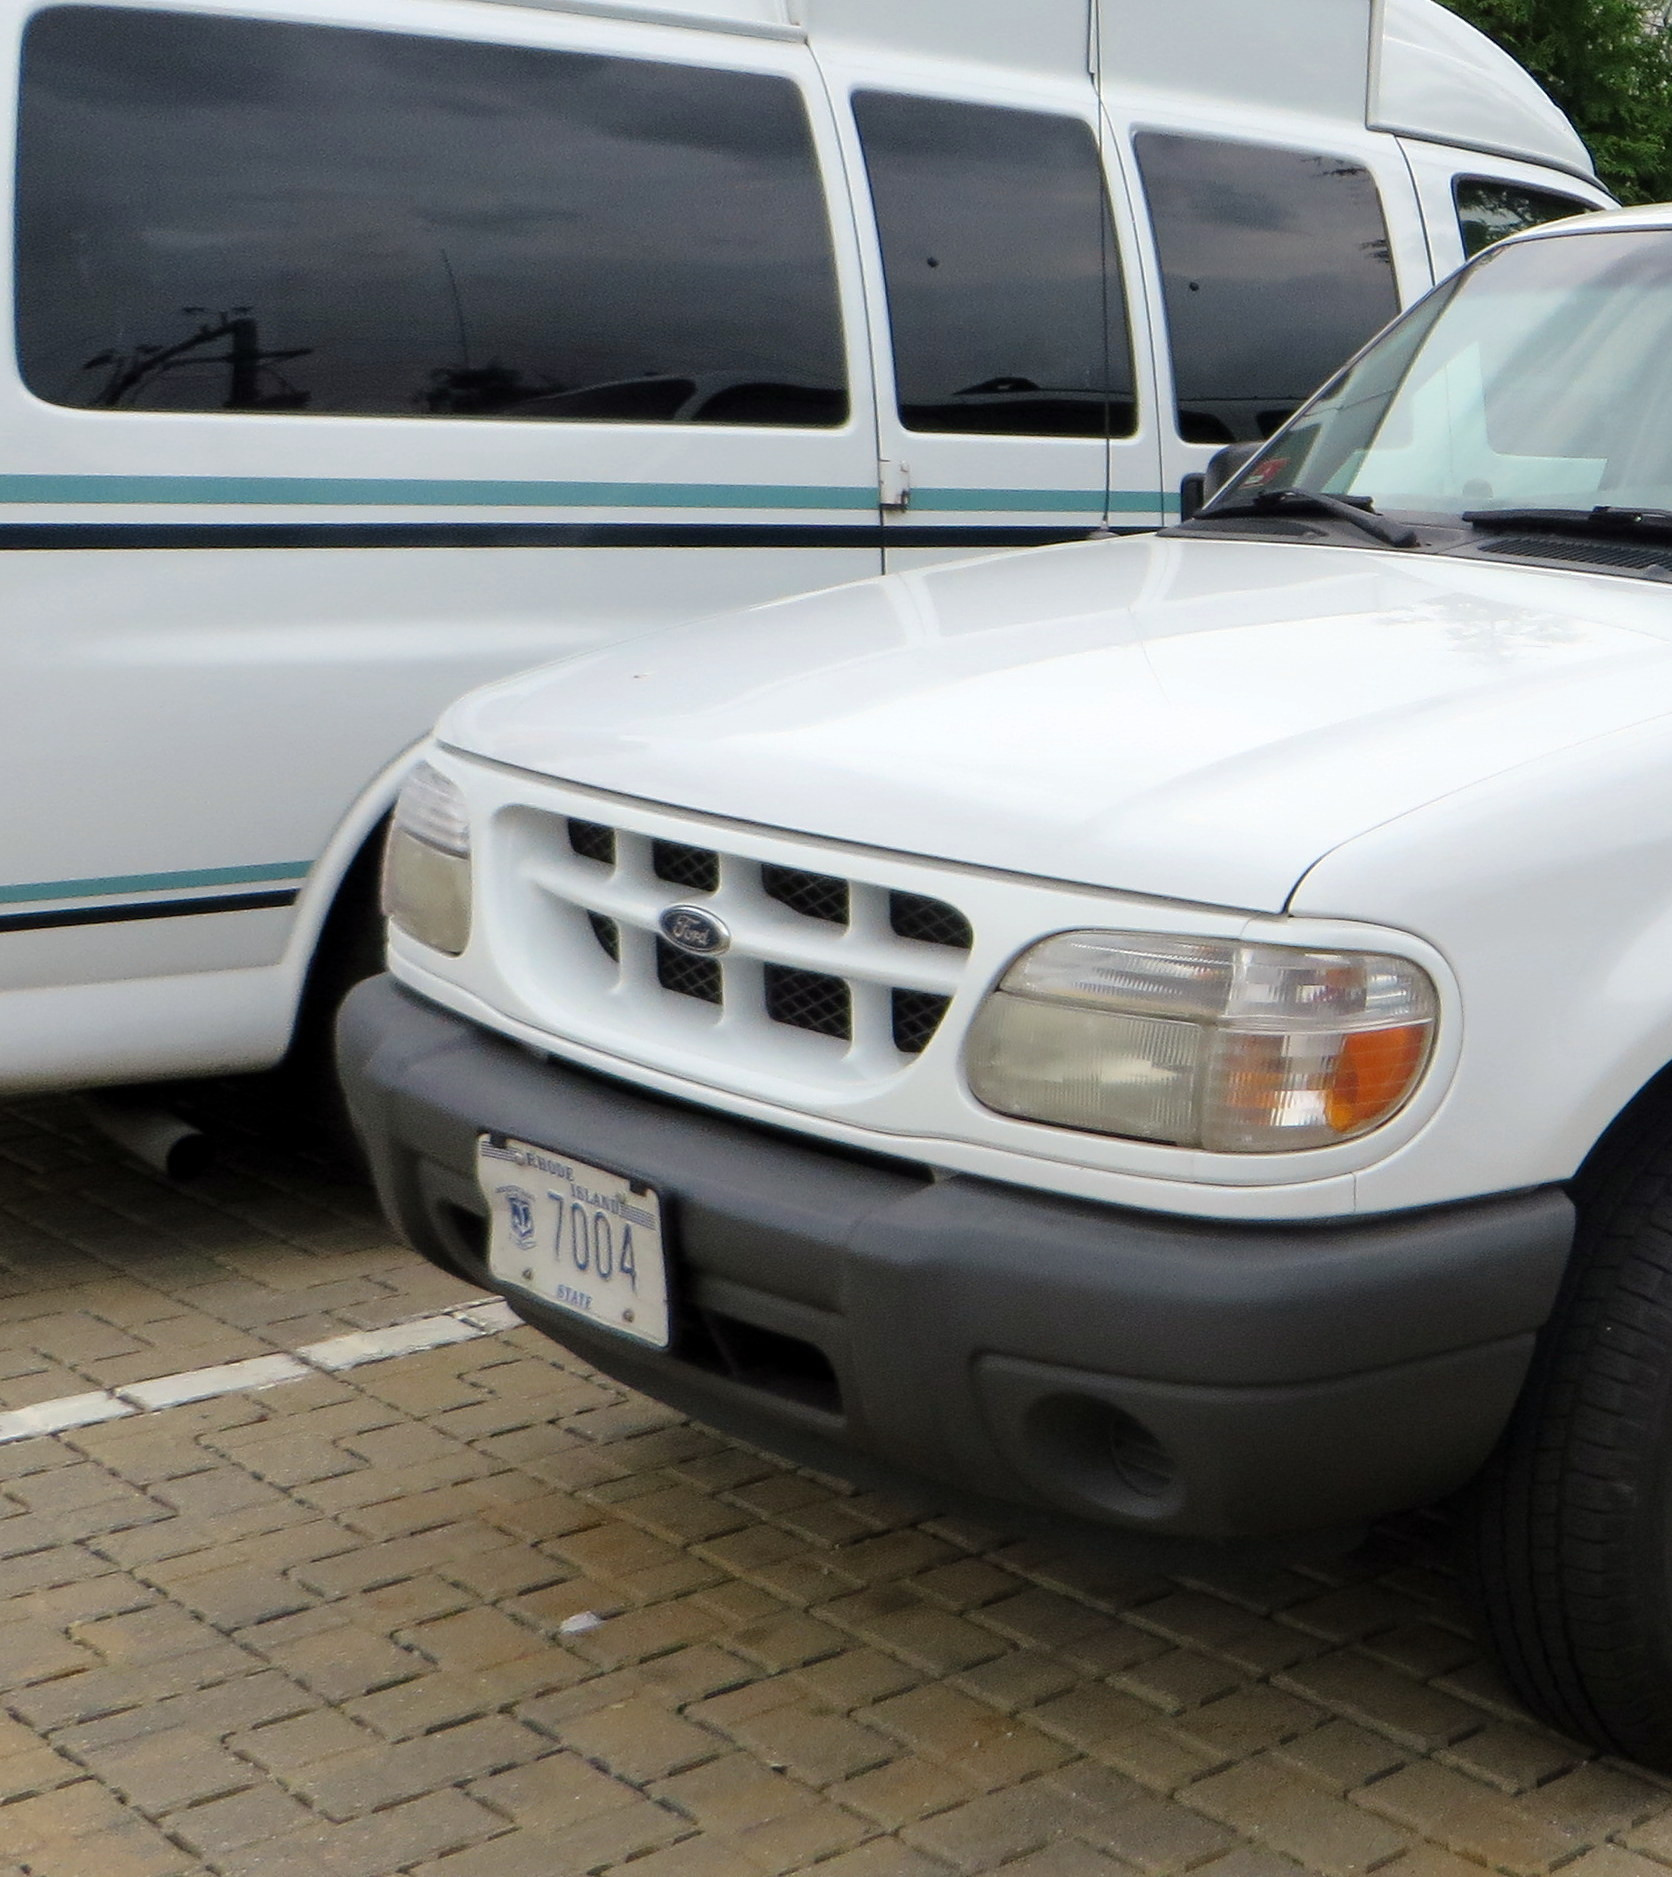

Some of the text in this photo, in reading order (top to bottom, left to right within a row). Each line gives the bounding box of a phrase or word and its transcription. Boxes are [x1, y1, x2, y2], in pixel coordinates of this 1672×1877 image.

[672, 914, 711, 947] Ford
[525, 1152, 575, 1182] RHODE
[570, 1183, 621, 1216] ISLAND
[547, 1190, 638, 1296] 7004
[556, 1284, 593, 1310] STATE
